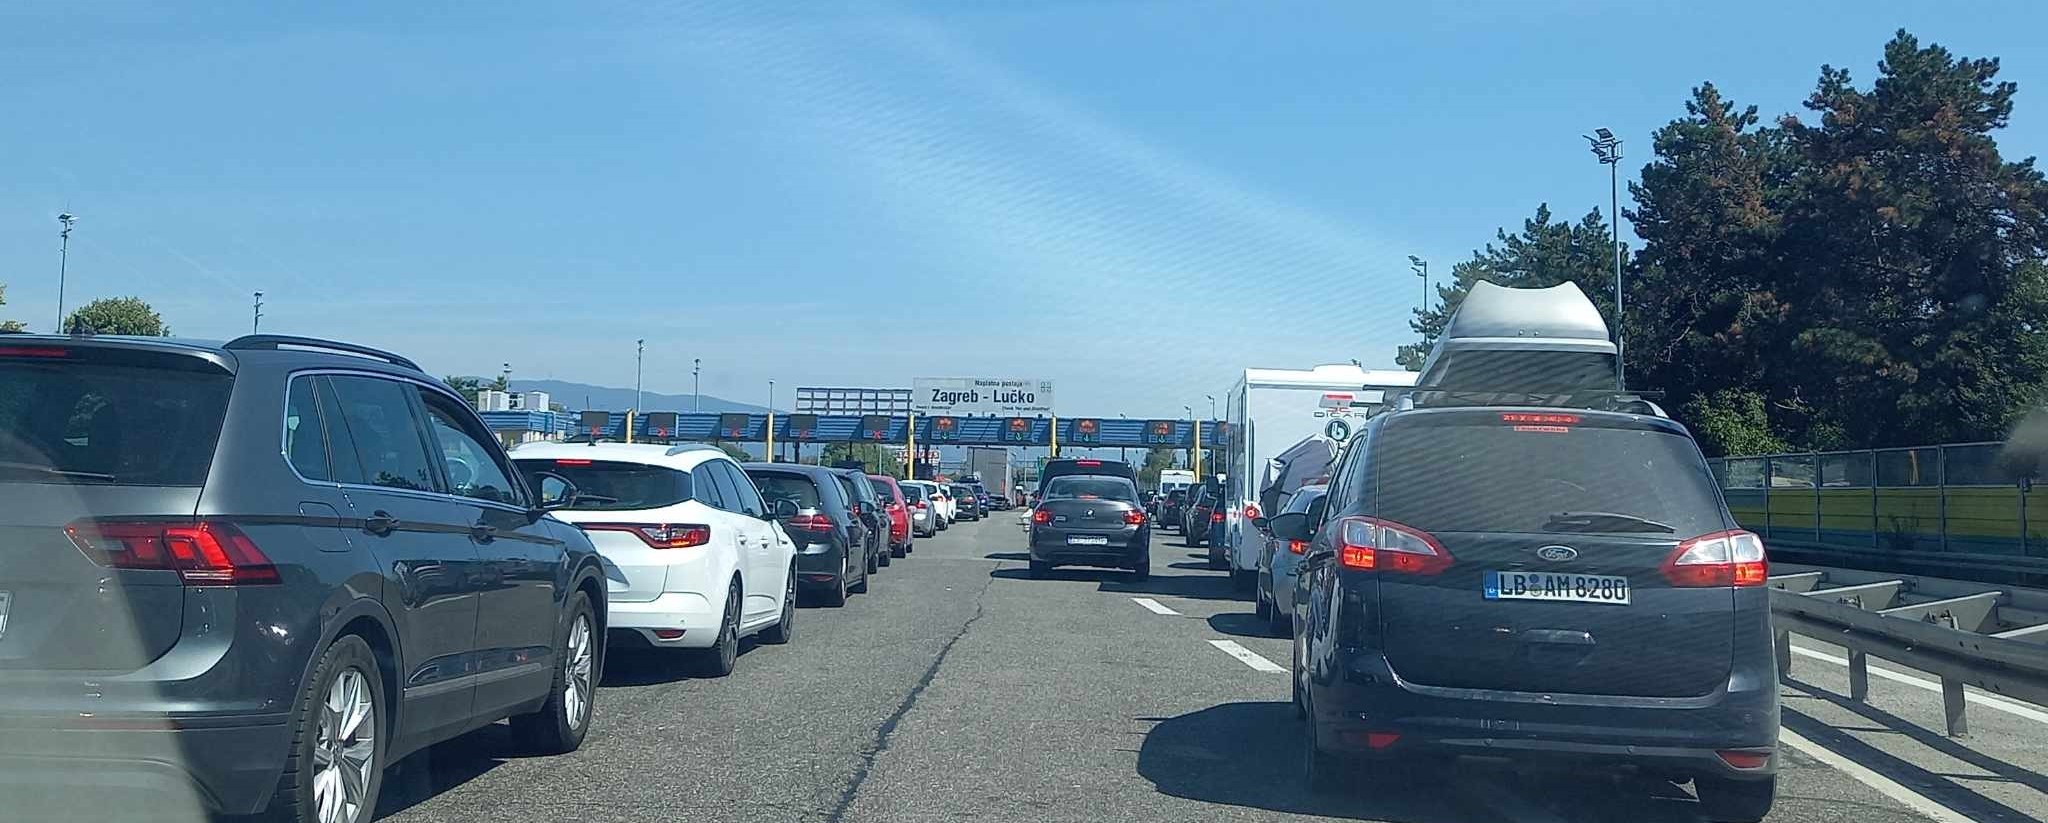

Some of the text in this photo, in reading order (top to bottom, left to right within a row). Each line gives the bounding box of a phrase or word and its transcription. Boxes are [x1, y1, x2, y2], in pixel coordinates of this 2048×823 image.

[932, 388, 979, 405] Zagreb
[993, 389, 1035, 403] Lučko
[1500, 574, 1626, 600] LB AM 8280
